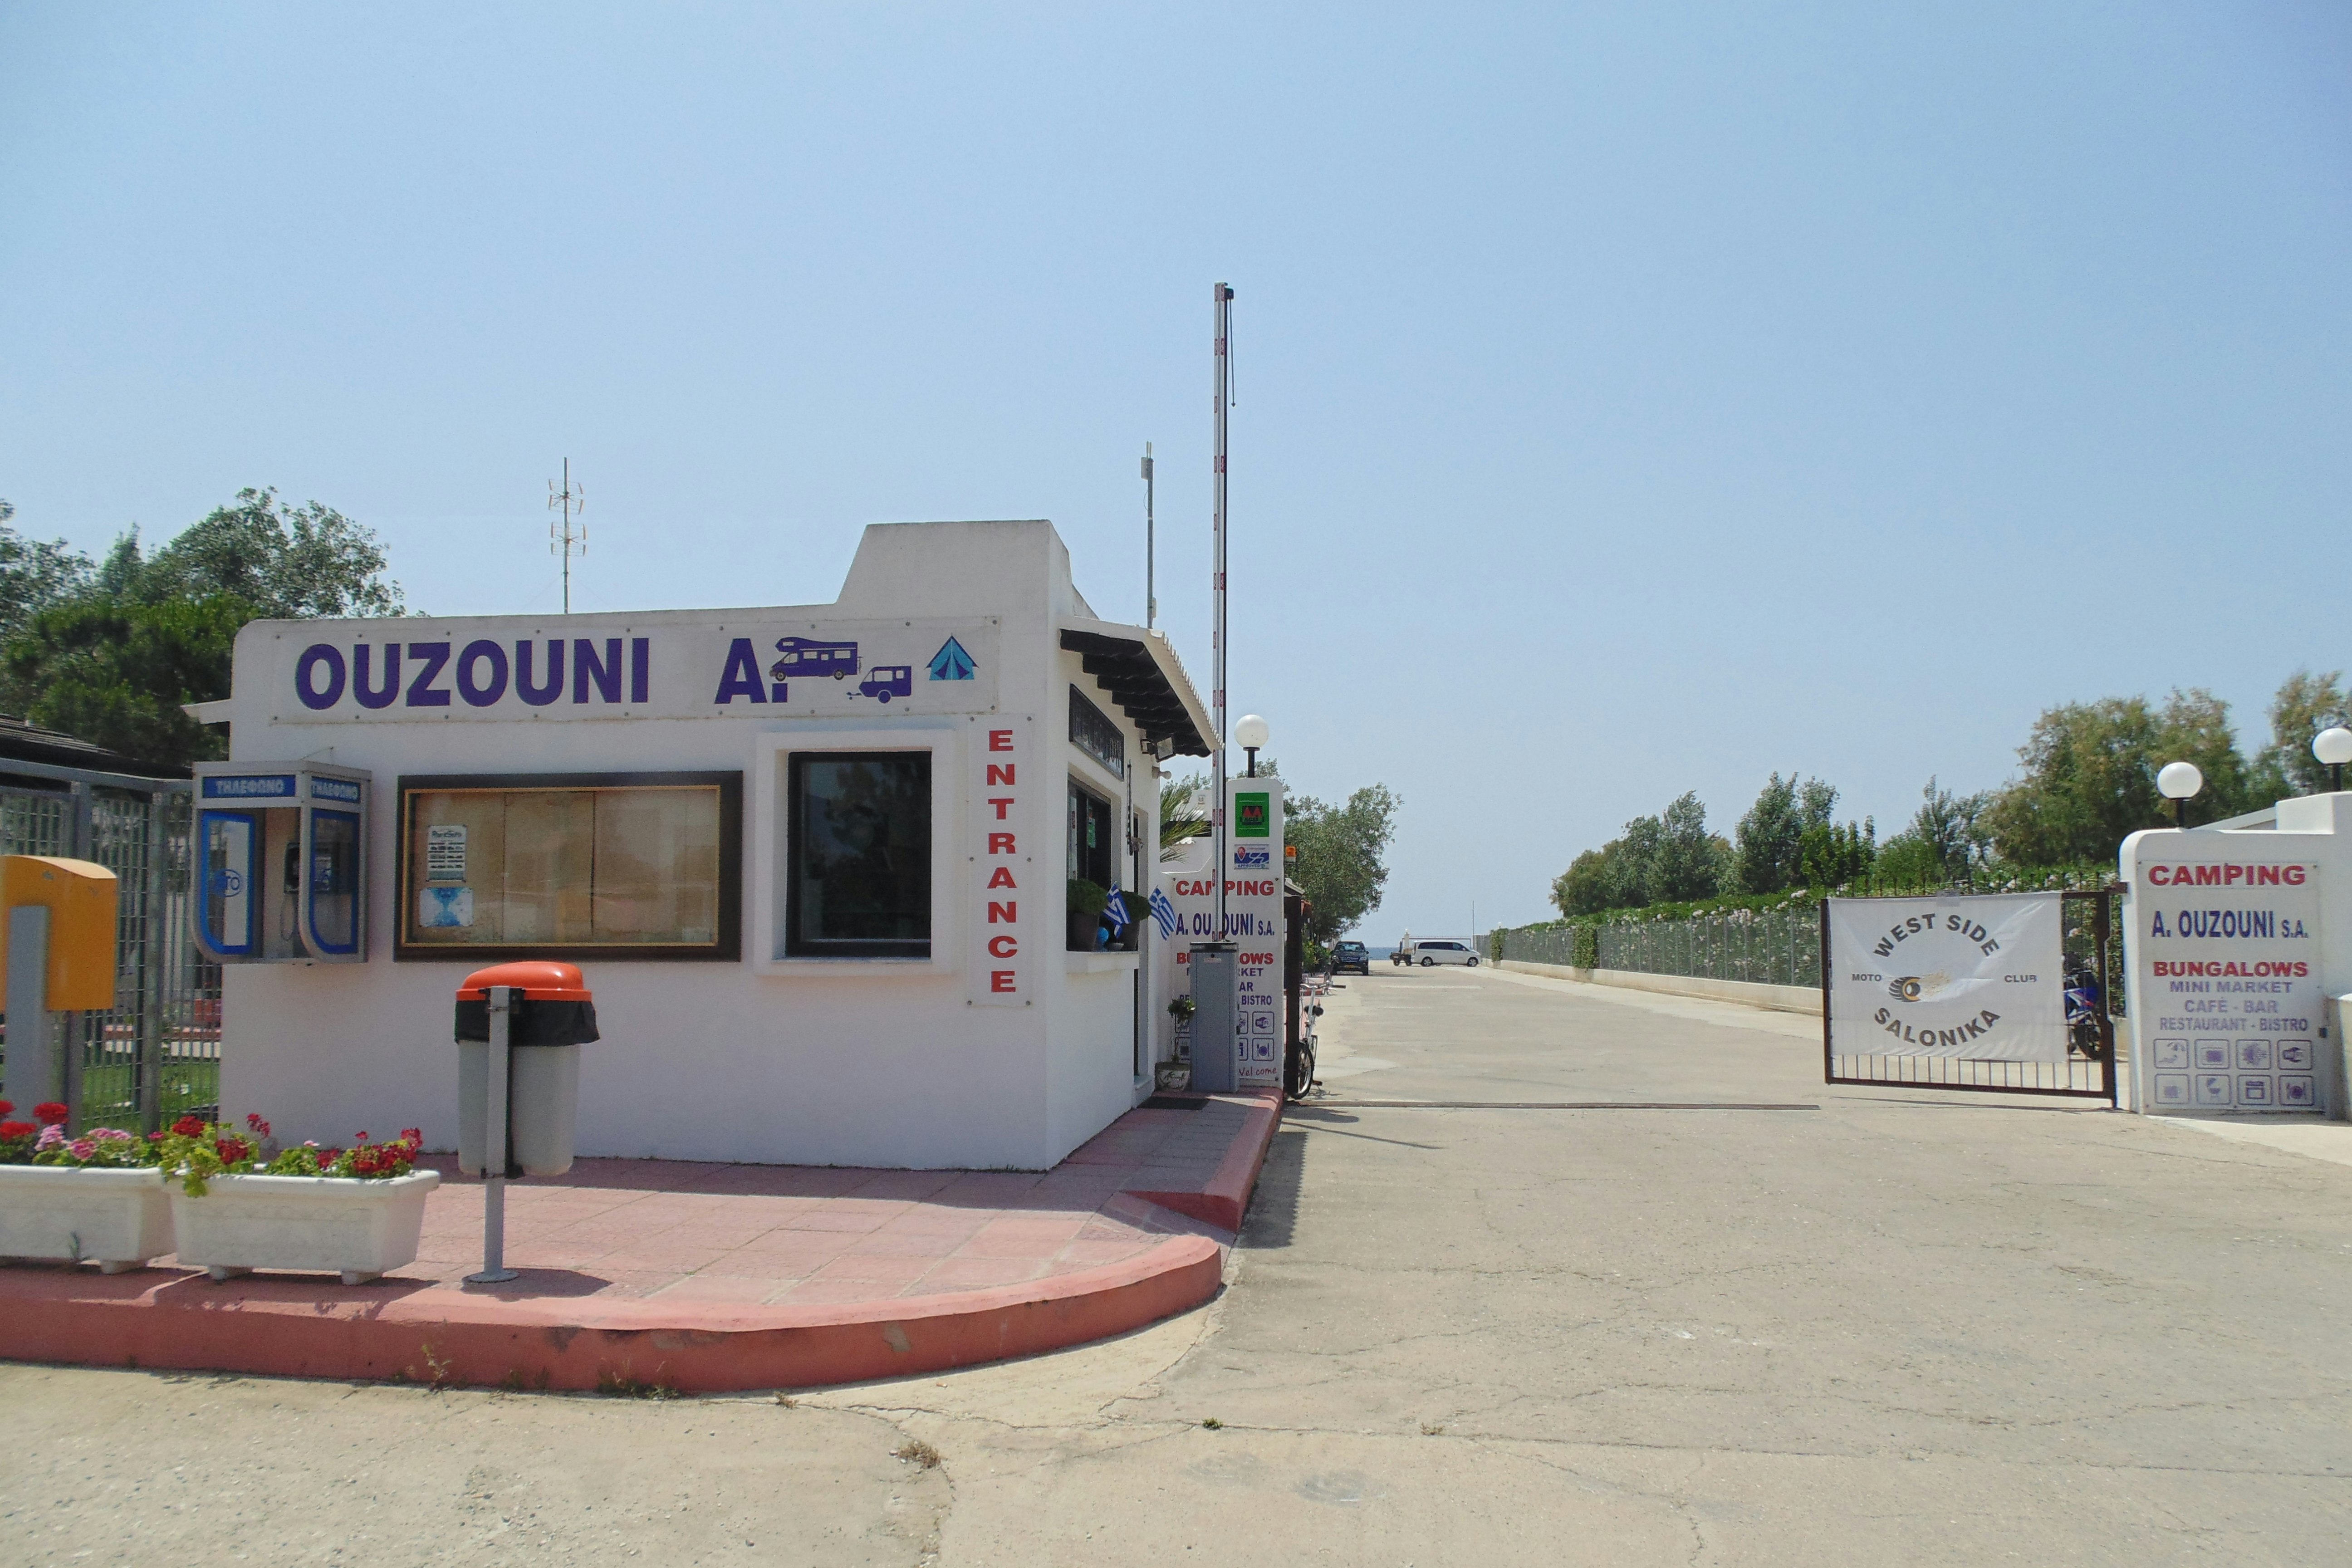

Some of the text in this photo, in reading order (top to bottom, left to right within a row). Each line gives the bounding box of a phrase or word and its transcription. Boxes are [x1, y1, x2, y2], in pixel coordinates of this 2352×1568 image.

[295, 637, 649, 709] OUZOUNI
[987, 730, 1018, 993] ENTRANCE
[2148, 865, 2306, 886] CAMPING
[1176, 913, 1188, 936] A.
[1193, 912, 1253, 936] OUUNI
[2151, 910, 2309, 938] A. OUZOUNI S.A.
[1873, 913, 2000, 958] WEST SIDE
[1852, 973, 2038, 983] MOTO CLUB
[2153, 961, 2308, 977] BUNGALOWS
[1239, 982, 1254, 992] AR
[2170, 981, 2293, 993] MINI MARKET
[1241, 995, 1272, 1005] BISTRO
[2244, 1000, 2278, 1013] BAR
[1874, 1007, 2001, 1047] SALONIKA
[2160, 1018, 2247, 1031] RESTAURANT
[2259, 1018, 2309, 1032] BISTRO
